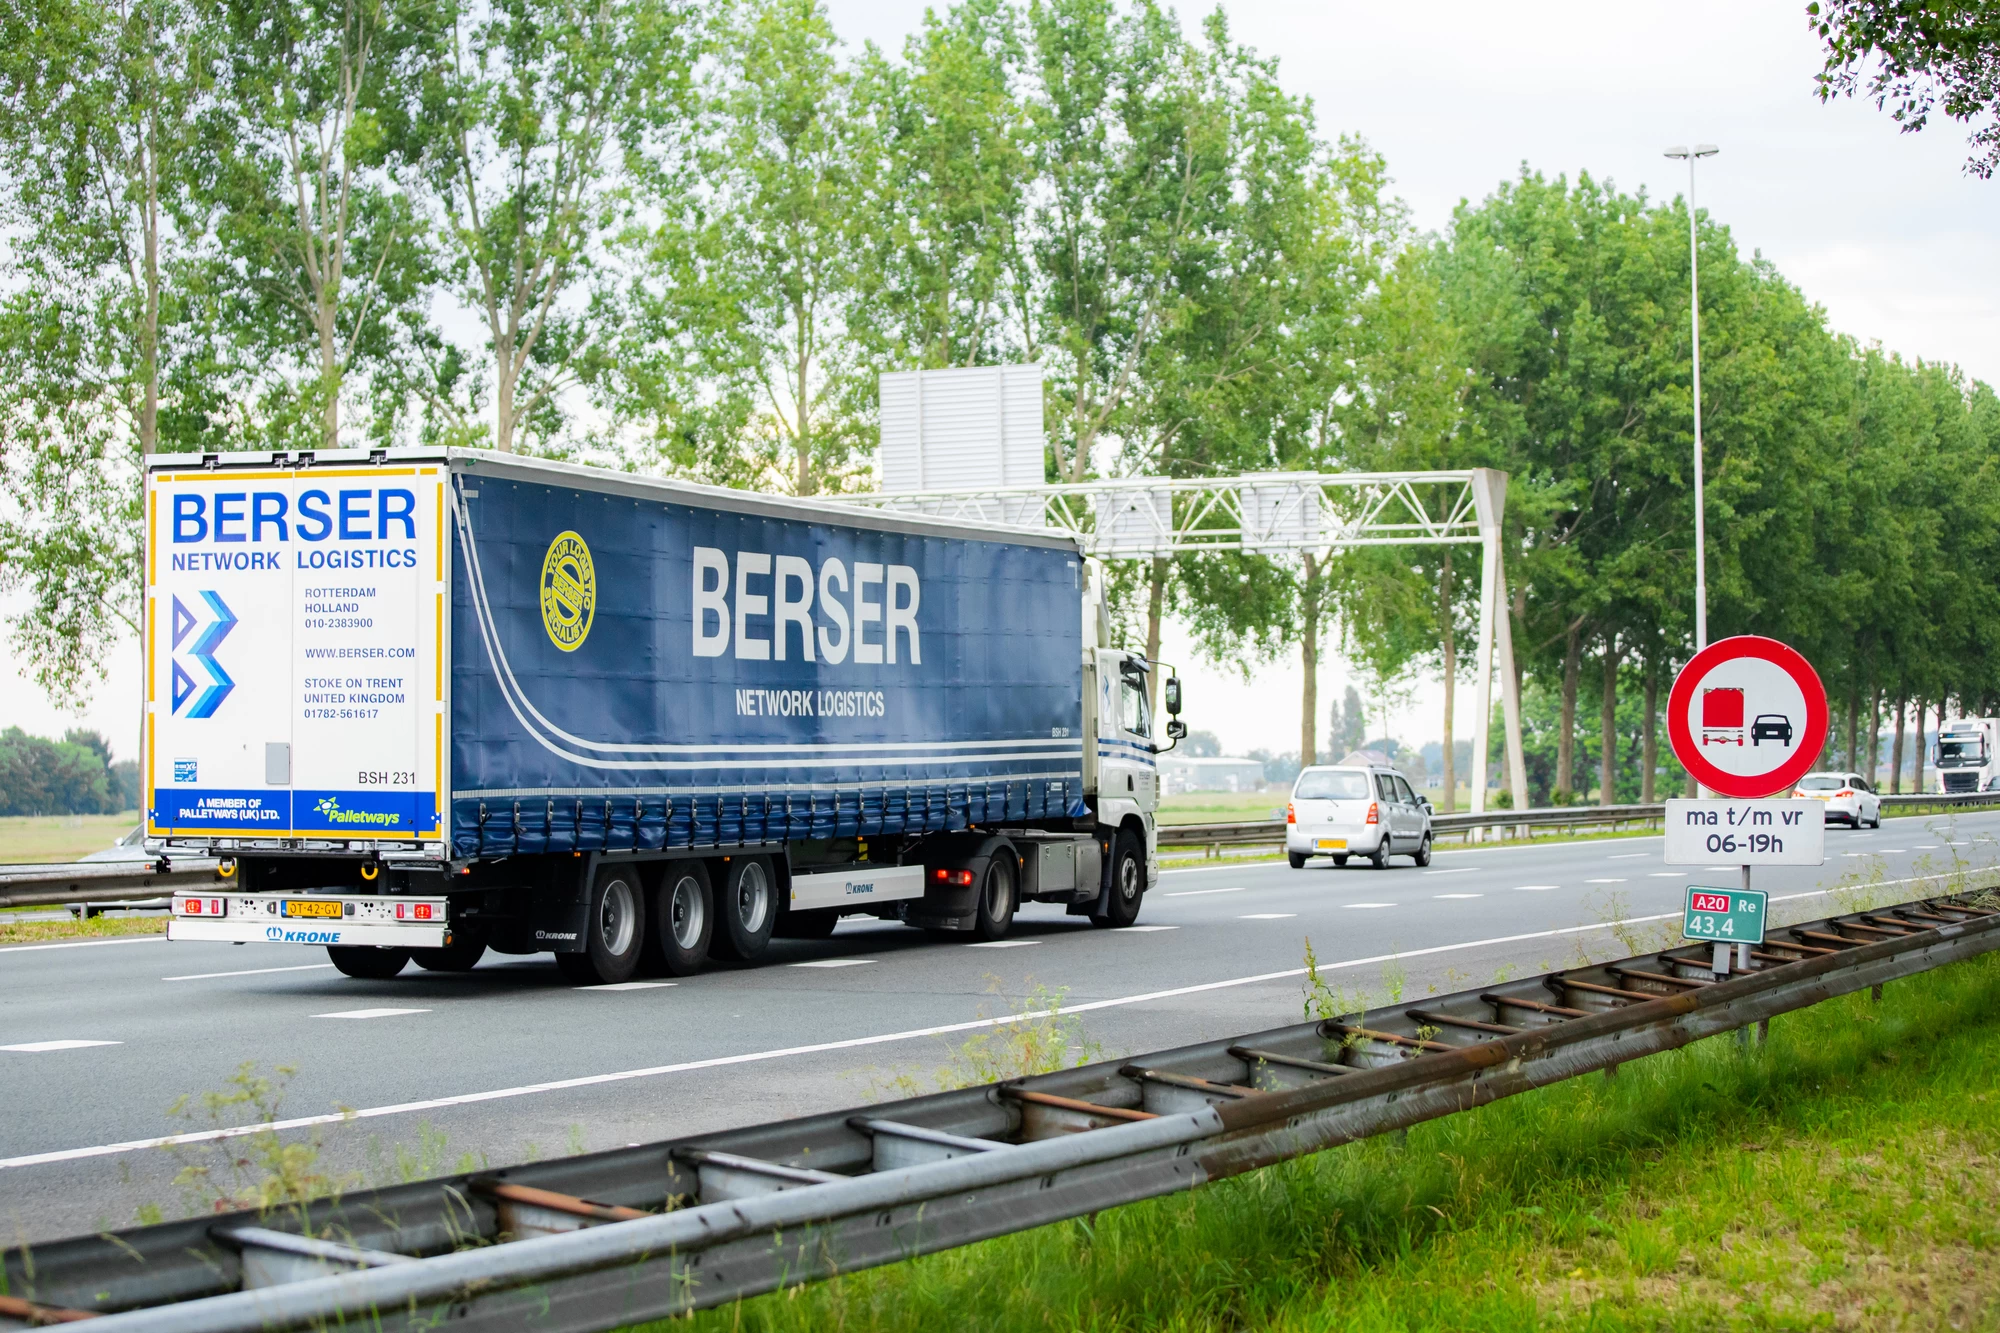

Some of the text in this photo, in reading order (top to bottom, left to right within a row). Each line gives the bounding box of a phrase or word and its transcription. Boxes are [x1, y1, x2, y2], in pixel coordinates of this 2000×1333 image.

[173, 488, 416, 543] BERSER
[172, 549, 417, 571] NETWORK LOGISTICS
[547, 540, 592, 610] YOUR LOGISTIC
[305, 587, 376, 598] ROTTERDAM
[552, 571, 583, 610] BERSER
[305, 602, 359, 613] HOLLAND
[692, 545, 921, 665] BERSER
[544, 587, 584, 642] SPECIALIST
[305, 618, 373, 628] 010-2383900
[305, 648, 415, 658] WWW.BERSER.COM
[304, 678, 403, 688] STOKE ON TRENT
[304, 693, 405, 704] UNITED KINGDOM
[735, 688, 885, 717] NETWORK LOGISTICS
[304, 709, 378, 719] 01782-561617
[358, 771, 416, 785] BSH 231
[197, 798, 262, 808] A MEMBER OF
[179, 808, 280, 821] PALLETWAYS (UK) LTD.
[328, 809, 400, 826] Palletways
[1686, 806, 1803, 826] ma t/m vr
[1706, 834, 1783, 853] 06-19h
[852, 884, 874, 894] KRONE
[1697, 895, 1757, 913] A20 Re
[1689, 915, 1734, 937] 43,4
[284, 931, 341, 943] KRONE
[544, 931, 578, 941] KRONE
